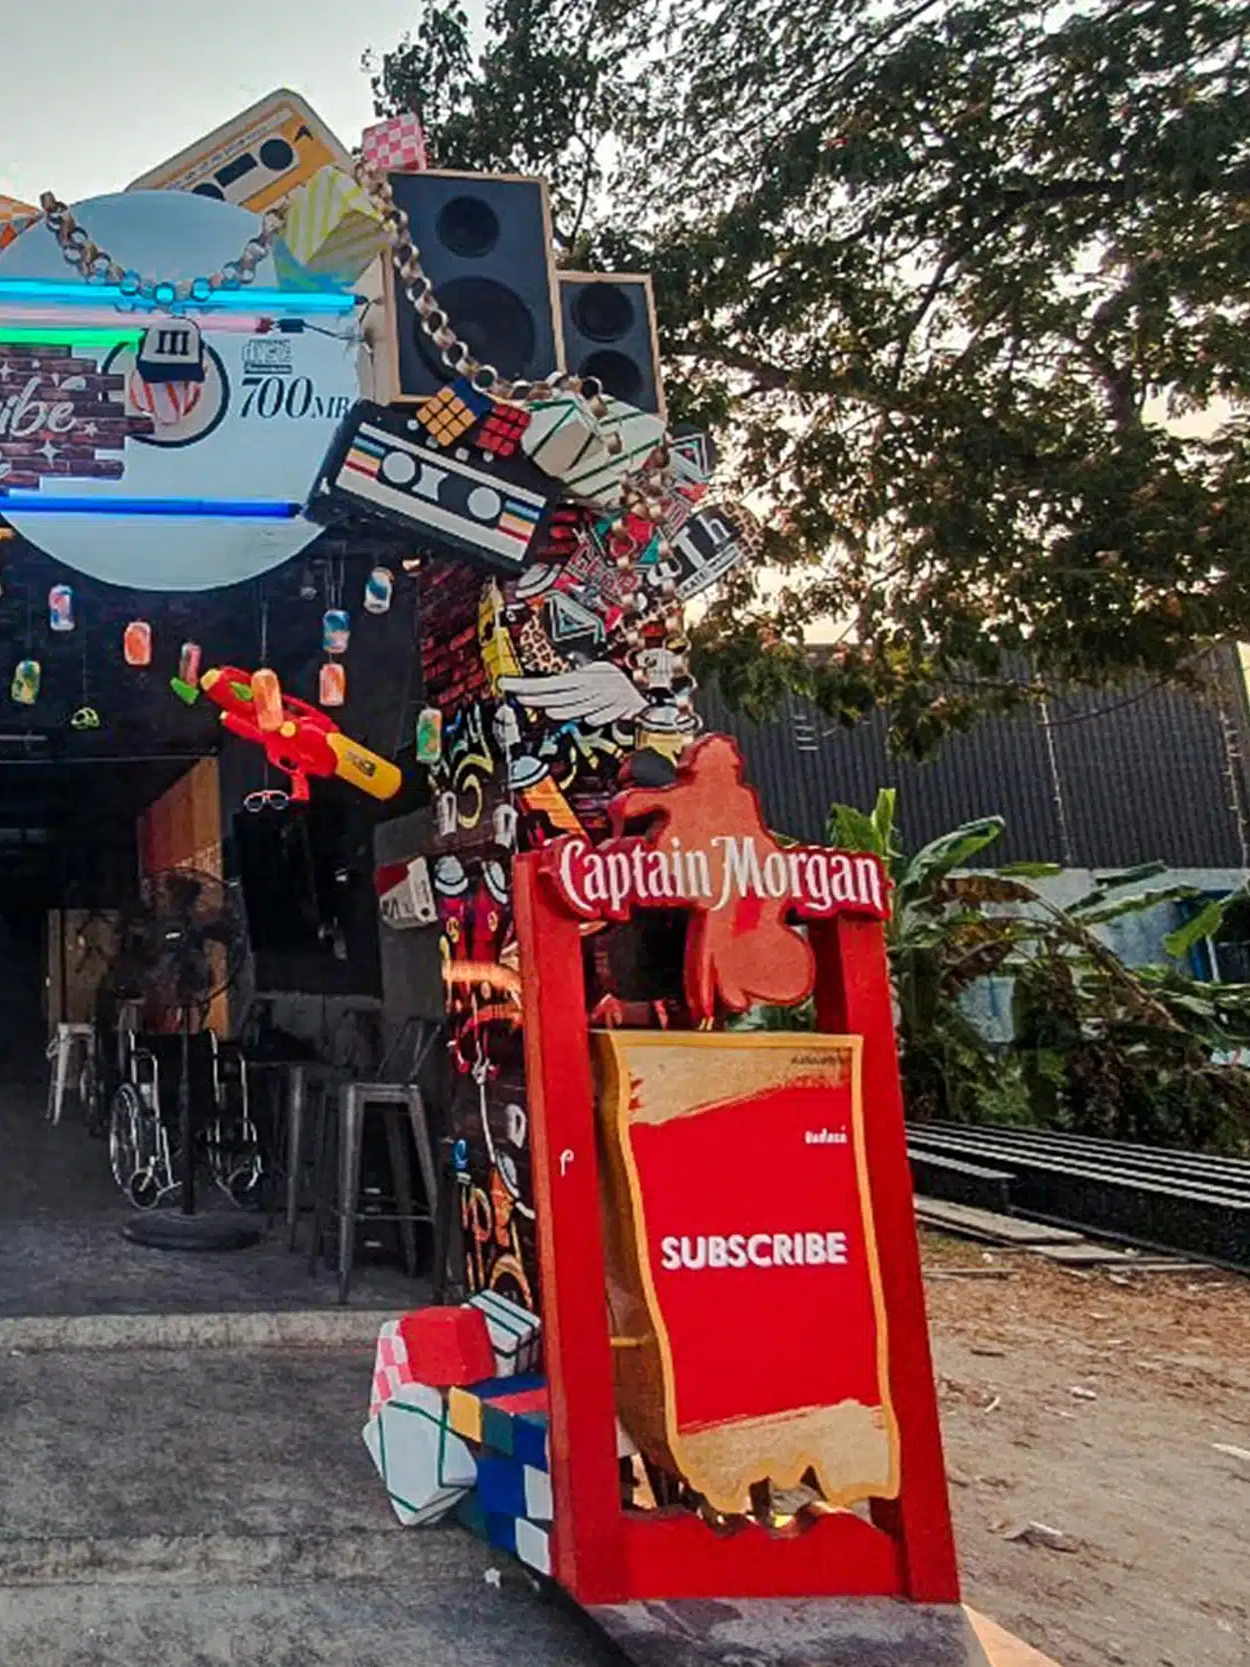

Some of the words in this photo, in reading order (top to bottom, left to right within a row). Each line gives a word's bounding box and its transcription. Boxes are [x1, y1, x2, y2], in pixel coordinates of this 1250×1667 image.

[559, 837, 712, 911] Captain
[711, 836, 884, 912] Morgan
[660, 1232, 849, 1270] SUBSCRIBE
